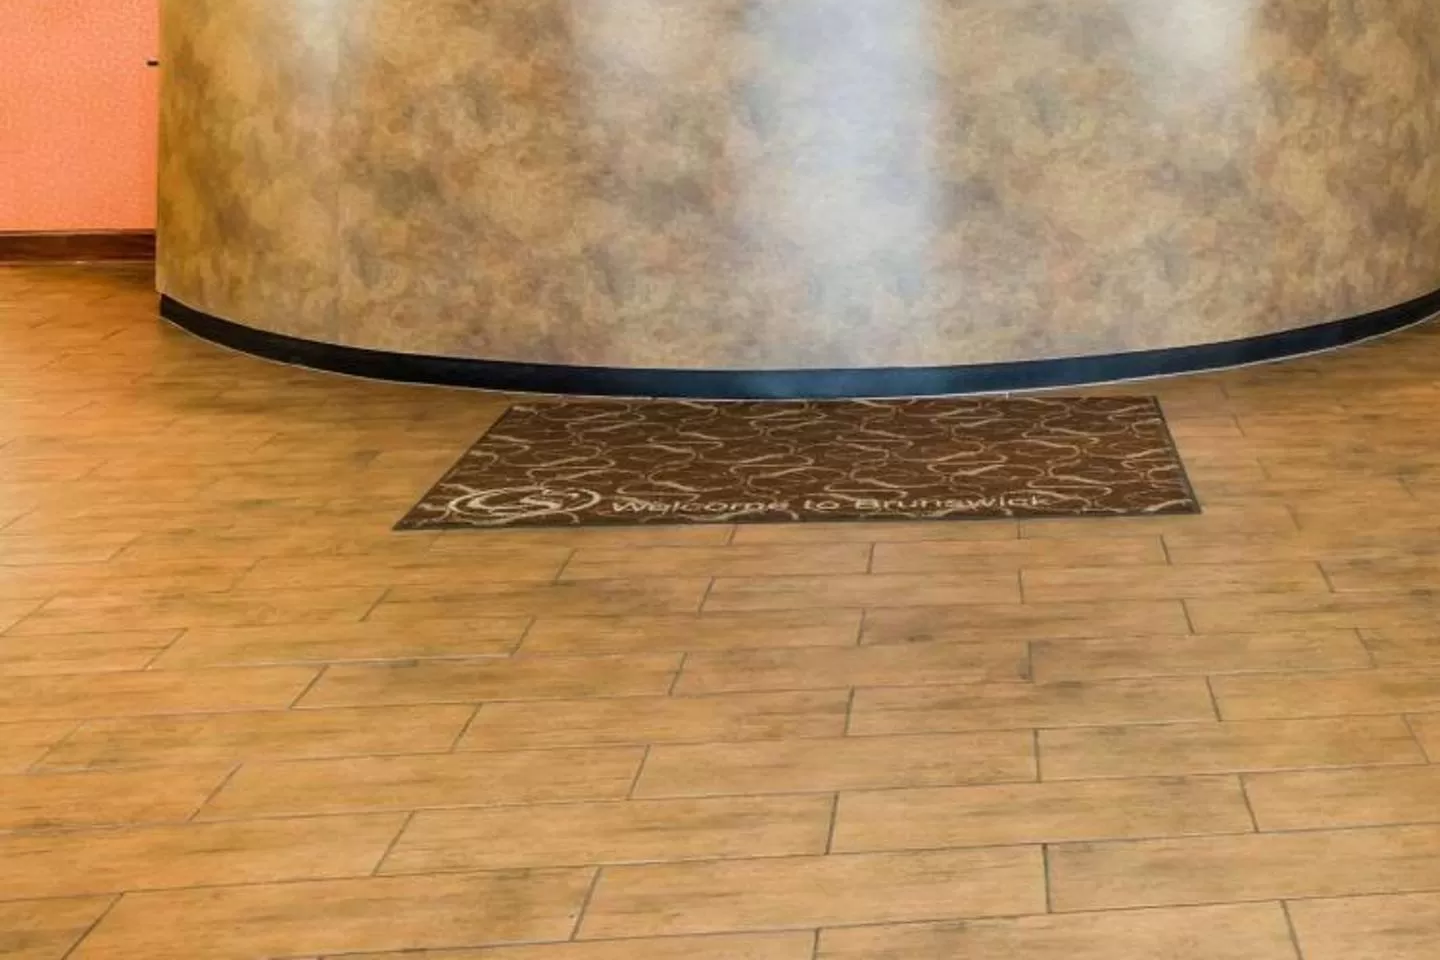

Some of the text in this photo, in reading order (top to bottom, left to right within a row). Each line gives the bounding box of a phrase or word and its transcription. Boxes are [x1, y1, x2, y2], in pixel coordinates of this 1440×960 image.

[612, 494, 1053, 515] Welcome to Brunswick
